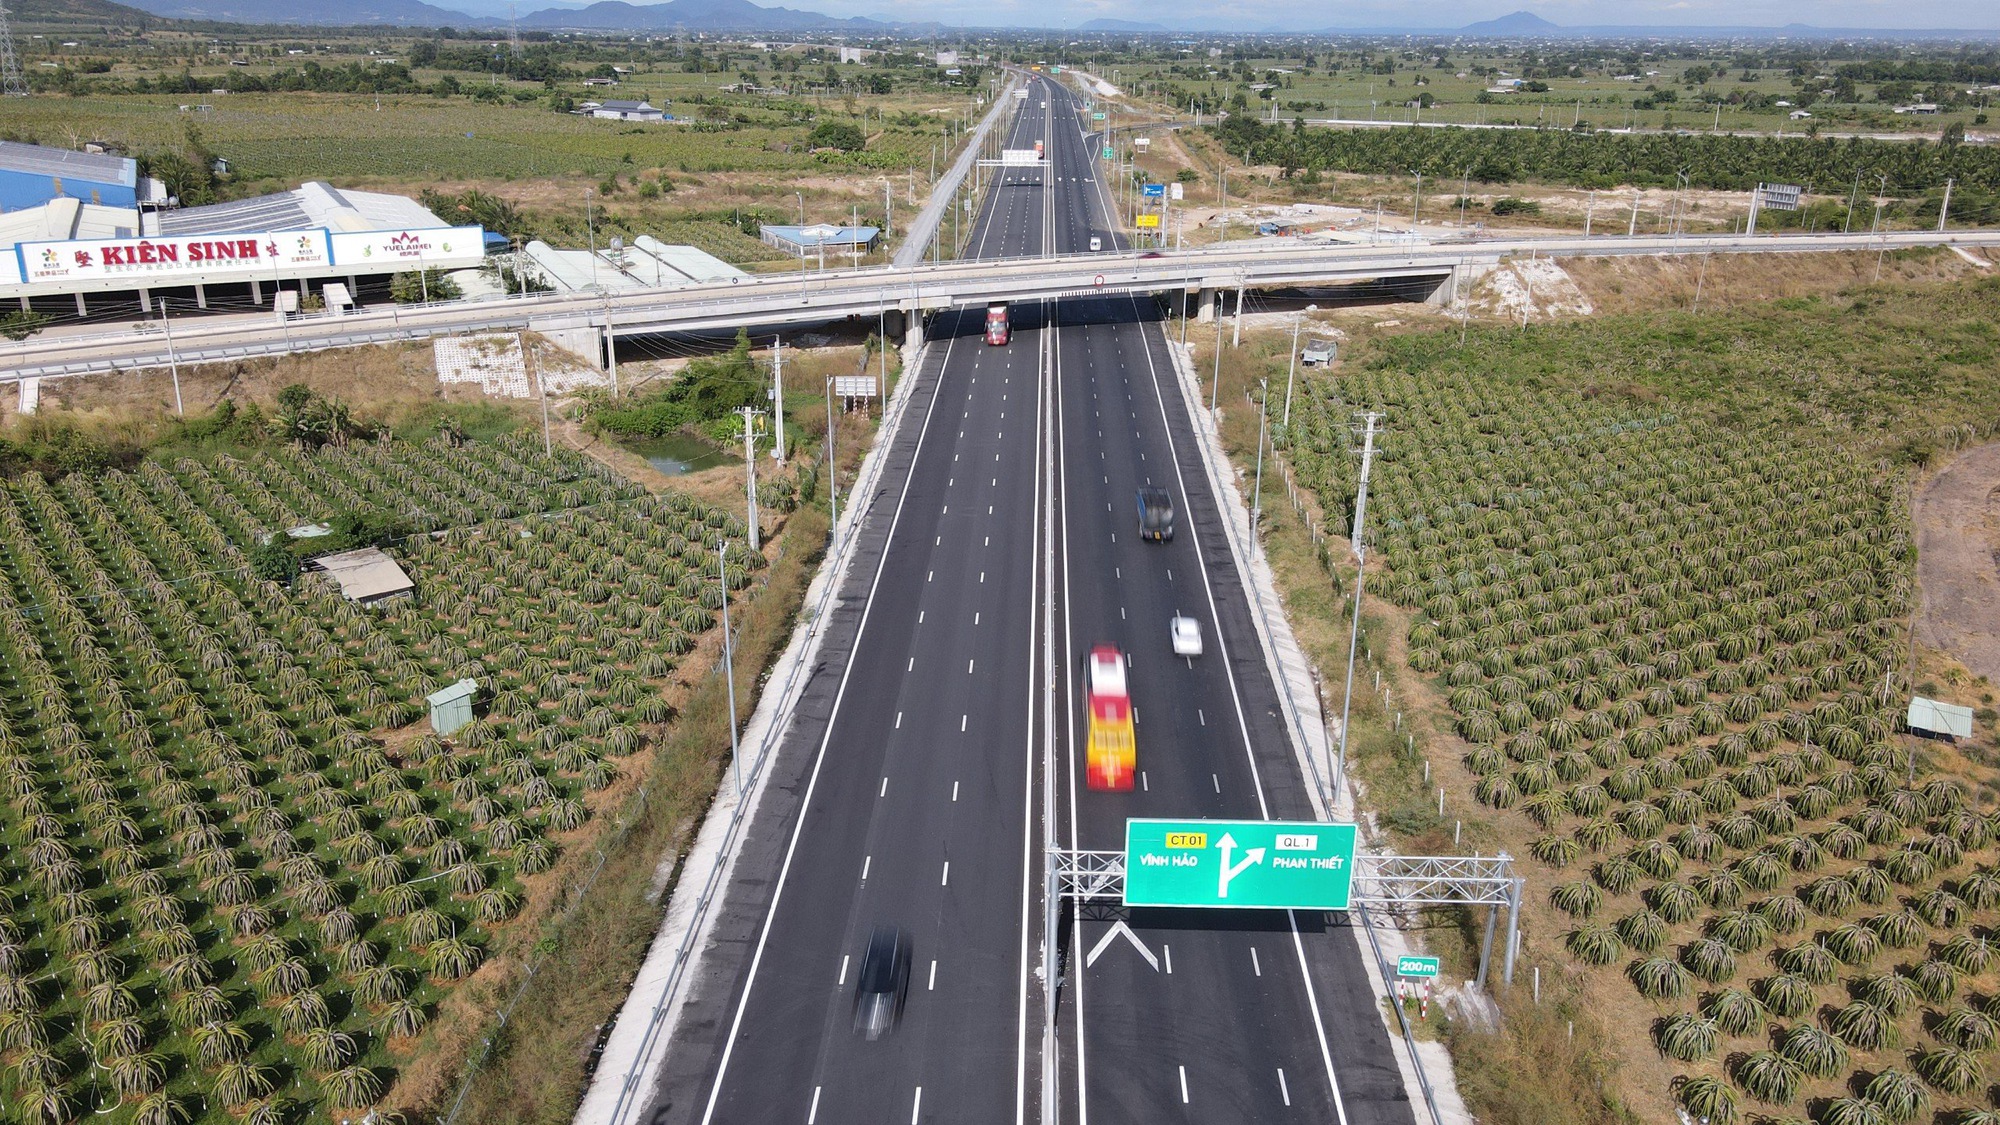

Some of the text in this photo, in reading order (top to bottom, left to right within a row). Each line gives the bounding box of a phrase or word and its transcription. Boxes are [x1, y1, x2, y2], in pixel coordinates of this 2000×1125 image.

[100, 239, 259, 265] KIÊN SINH
[382, 243, 432, 252] YUELAIMEI
[1170, 834, 1203, 846] CT.01
[1283, 837, 1310, 849] QL.1
[1172, 852, 1198, 867] HẢO
[1272, 854, 1344, 870] PHAN THIẾT
